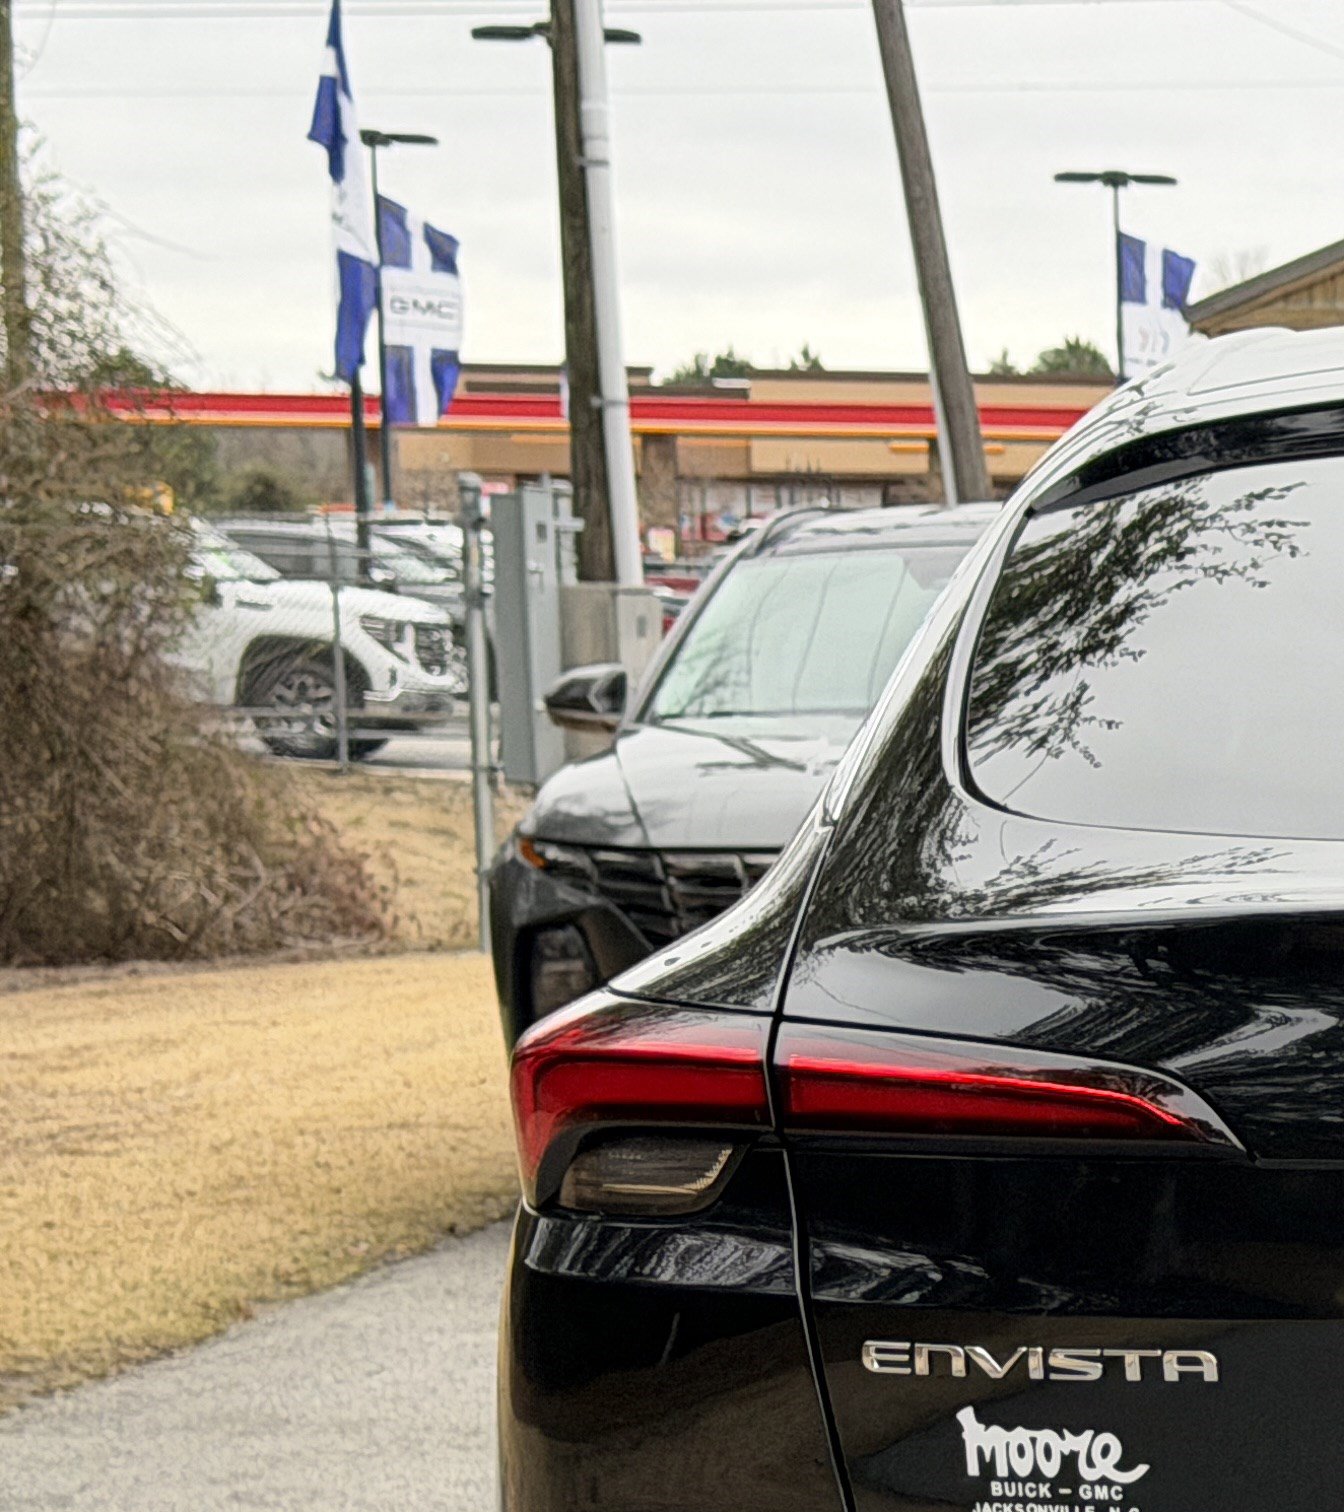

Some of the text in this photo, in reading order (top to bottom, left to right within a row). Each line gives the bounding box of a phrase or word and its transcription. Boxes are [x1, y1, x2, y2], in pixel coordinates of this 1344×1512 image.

[389, 295, 457, 320] GMC
[862, 1340, 1219, 1382] ENVISTA
[990, 1480, 1052, 1499] BUICK
[1078, 1483, 1124, 1501] GMC
